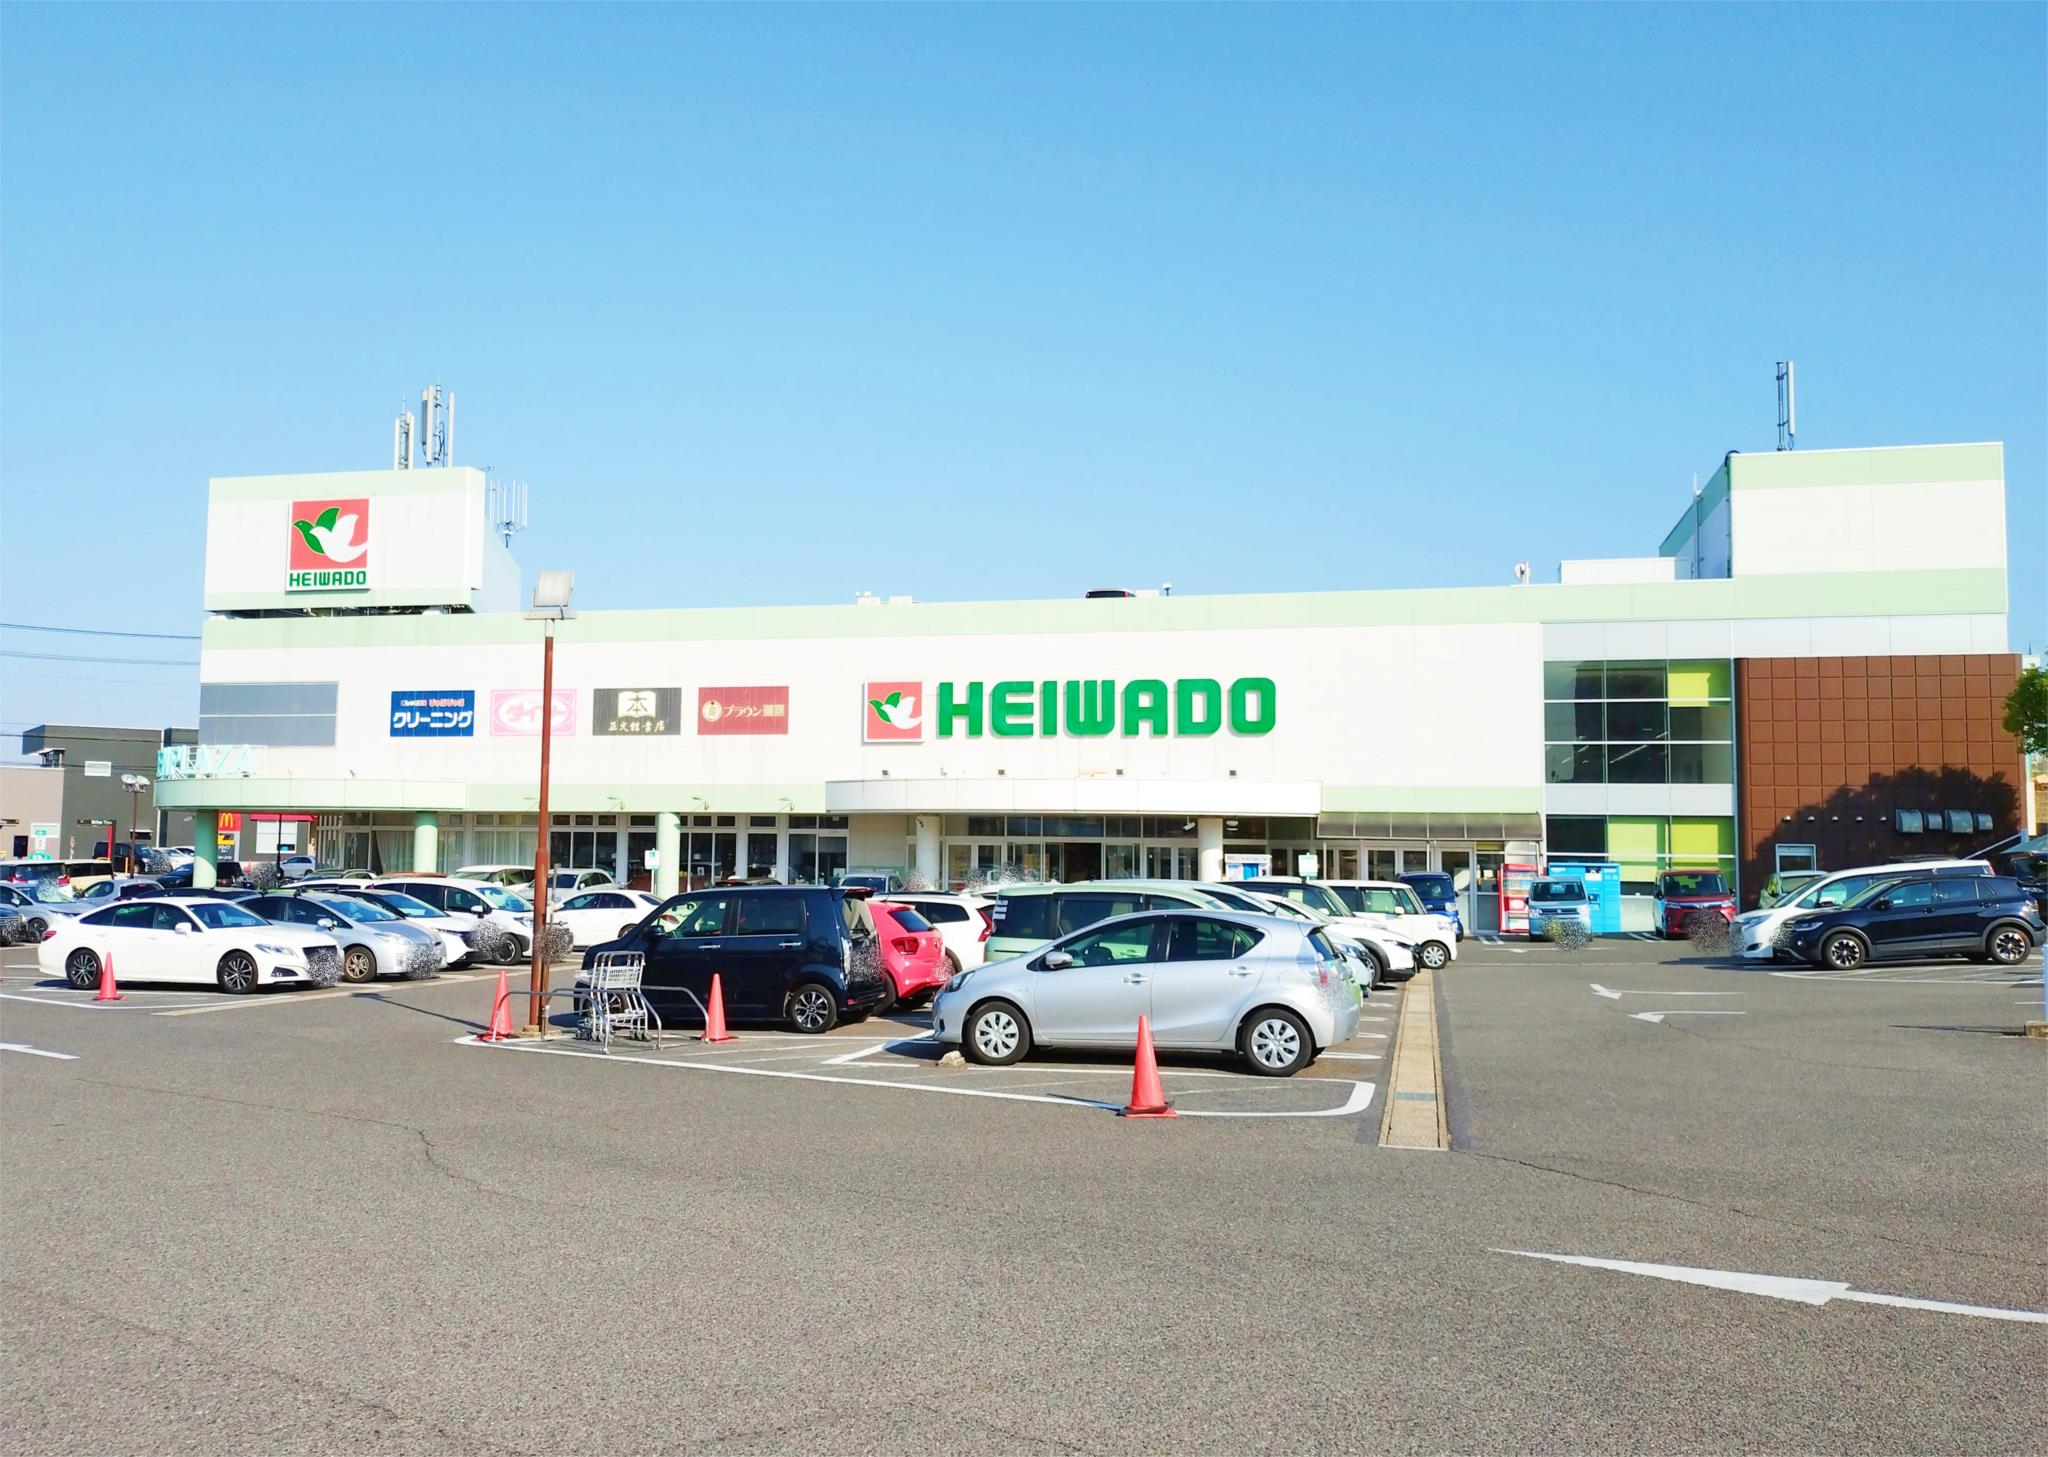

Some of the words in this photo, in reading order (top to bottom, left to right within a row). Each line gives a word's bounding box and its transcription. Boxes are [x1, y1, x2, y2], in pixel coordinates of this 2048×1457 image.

[289, 571, 367, 587] HEIWADO
[936, 678, 1276, 736] HEIWADO
[393, 711, 473, 729] クリーニング
